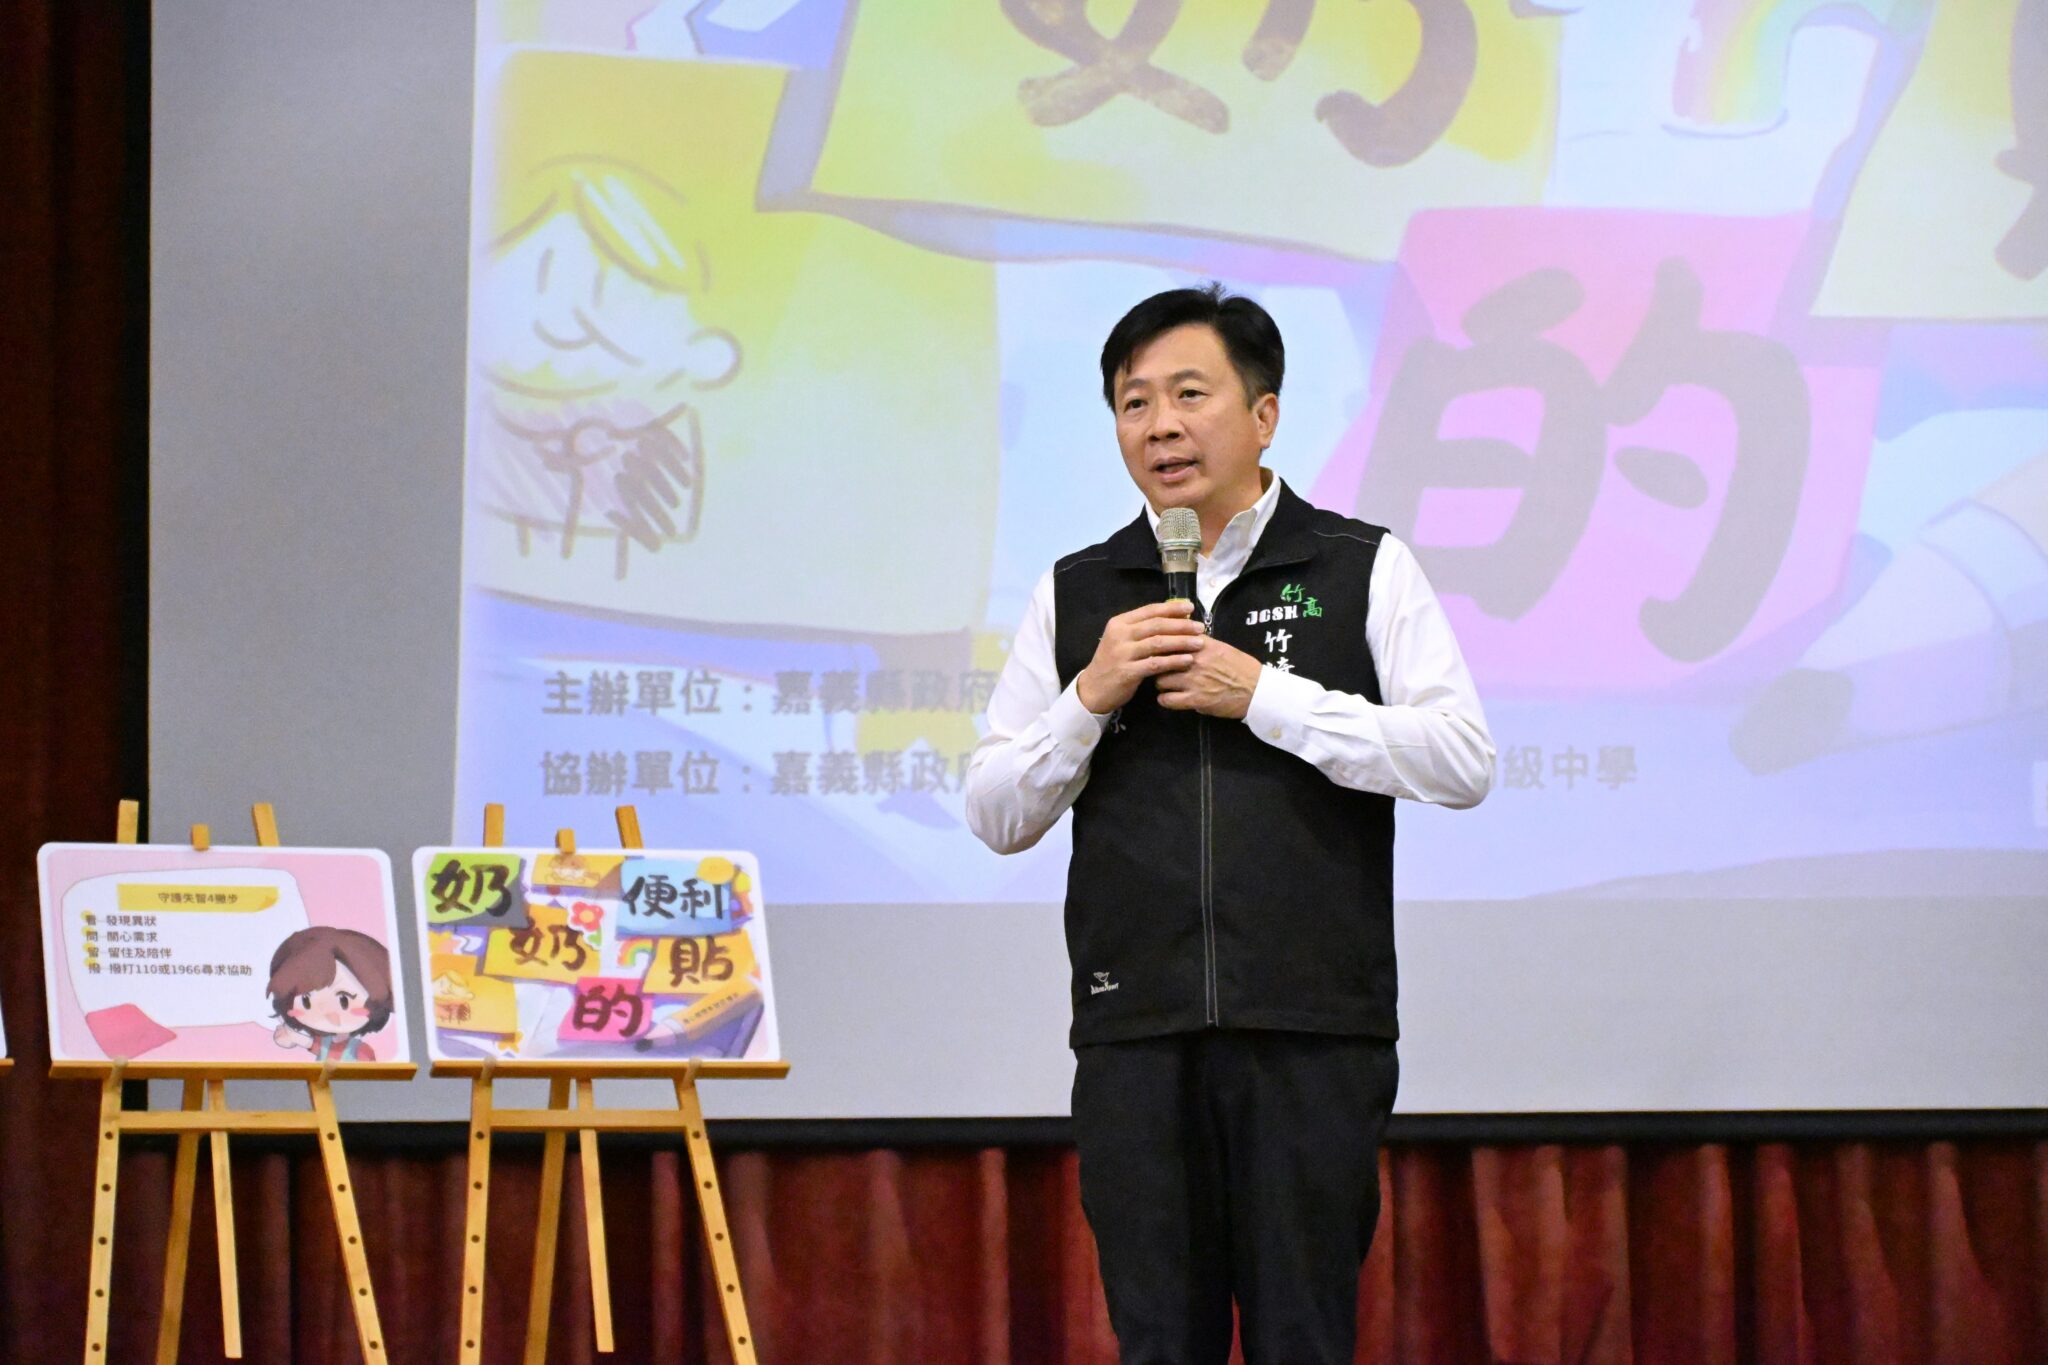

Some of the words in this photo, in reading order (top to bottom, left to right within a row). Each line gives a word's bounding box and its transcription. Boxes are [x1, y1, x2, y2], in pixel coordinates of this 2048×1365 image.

[1357, 256, 1812, 664] 的
[1245, 604, 1299, 626] JCSH
[541, 750, 972, 797] 協辦單位：嘉義縣政
[1490, 745, 1638, 791] 級中學
[431, 859, 512, 918] 奶
[622, 874, 724, 920] 便利
[509, 918, 588, 971] 奶
[669, 935, 735, 988] 貼
[571, 983, 644, 1038] 的
